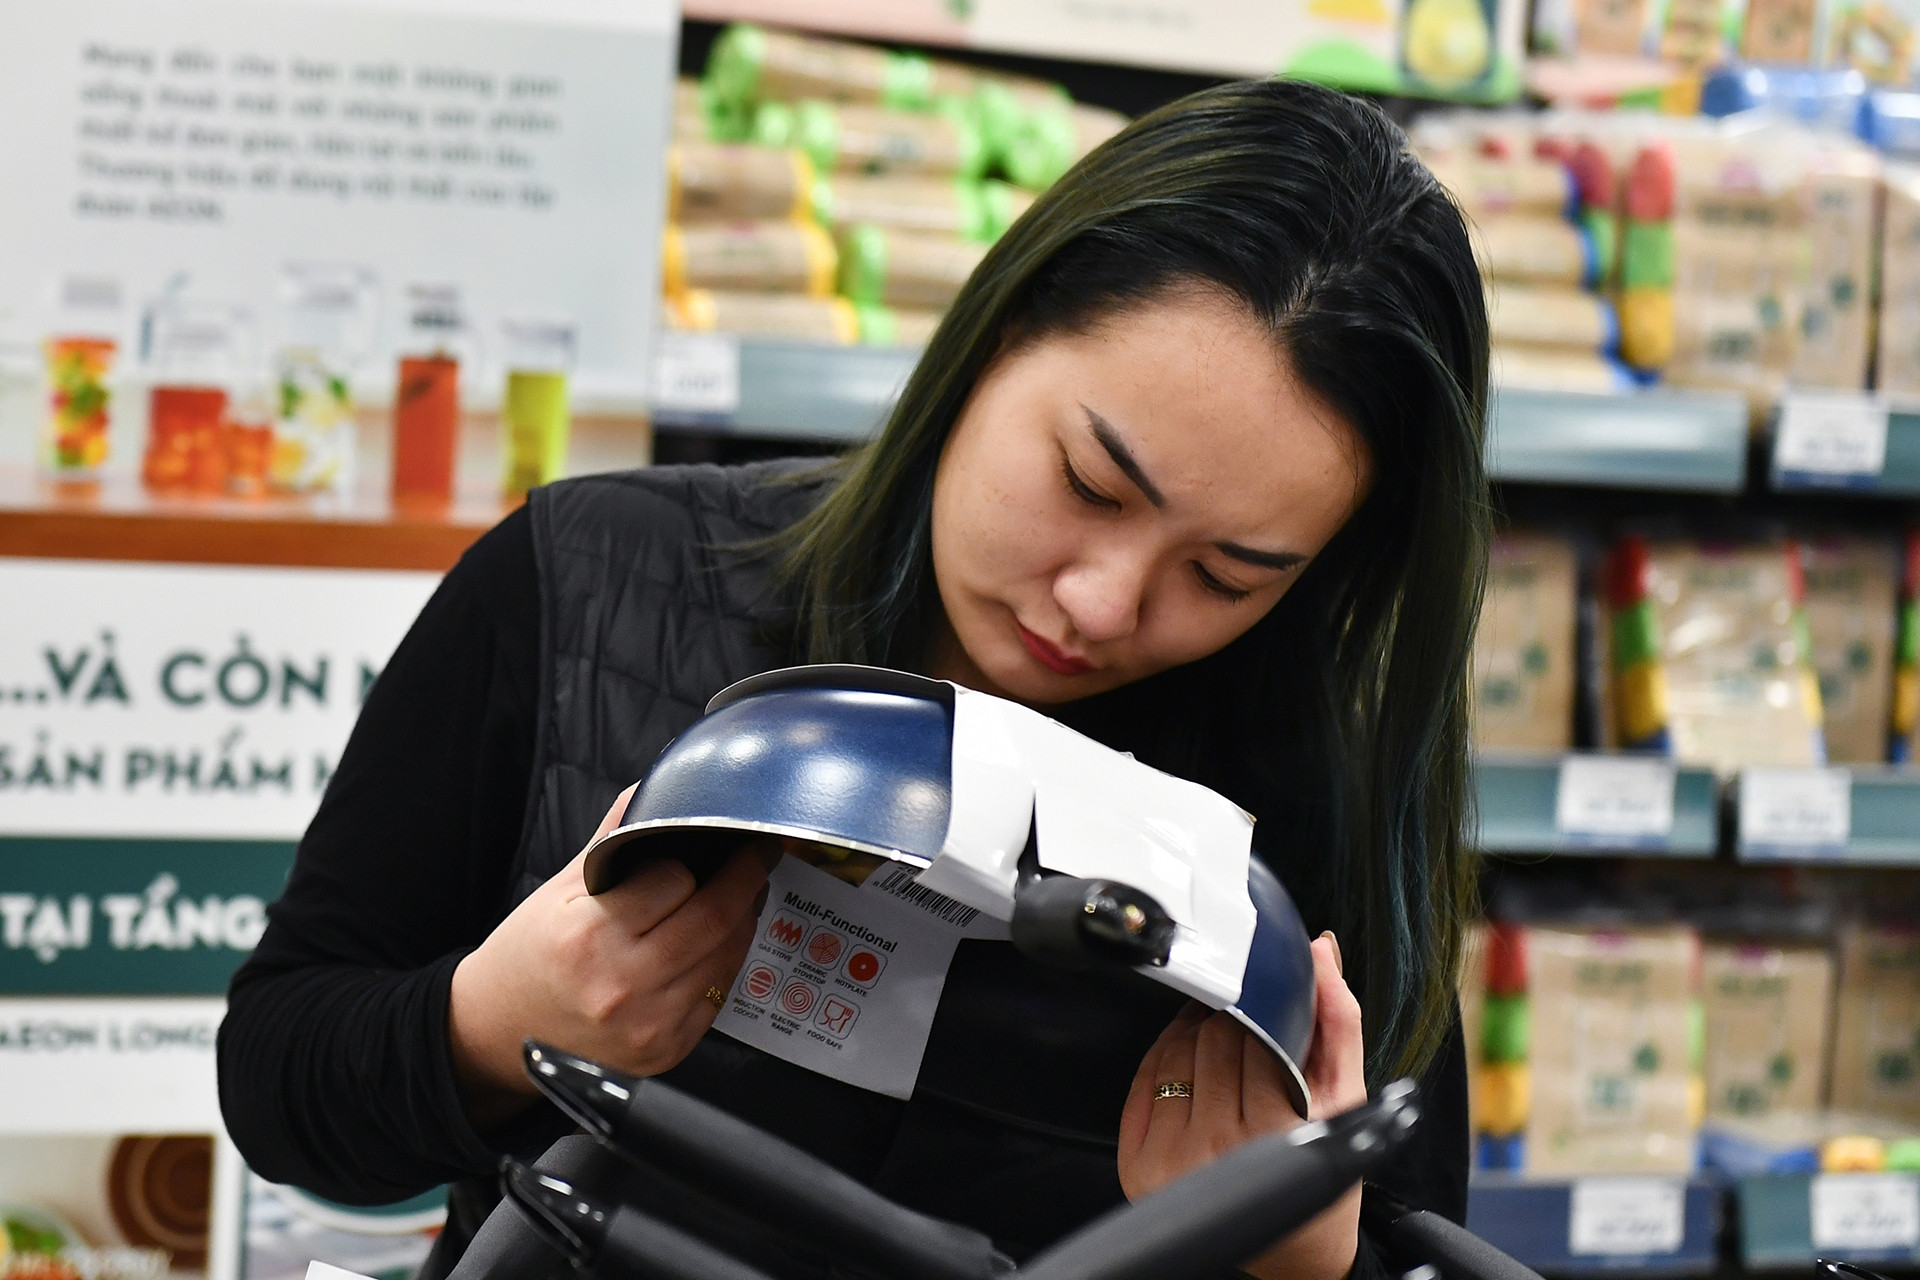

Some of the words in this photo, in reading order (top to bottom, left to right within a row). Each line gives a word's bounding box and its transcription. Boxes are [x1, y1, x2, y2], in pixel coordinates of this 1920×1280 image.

[160, 635, 329, 708] CÒN
[0, 893, 92, 963] TẠI
[783, 891, 898, 953] Multi-Functional
[759, 943, 772, 954] GAS
[771, 947, 793, 962] STOVE
[792, 967, 826, 985] STOVETOP
[798, 961, 828, 978] CERAMIC
[834, 978, 868, 997] HOTPLATE
[733, 1006, 760, 1020] COOKER
[734, 997, 766, 1015] INDUCTION
[770, 1012, 801, 1031] ELECTRIC
[771, 1022, 793, 1036] RANGE
[807, 1029, 826, 1043] FOOD
[825, 1037, 844, 1051] SAFE
